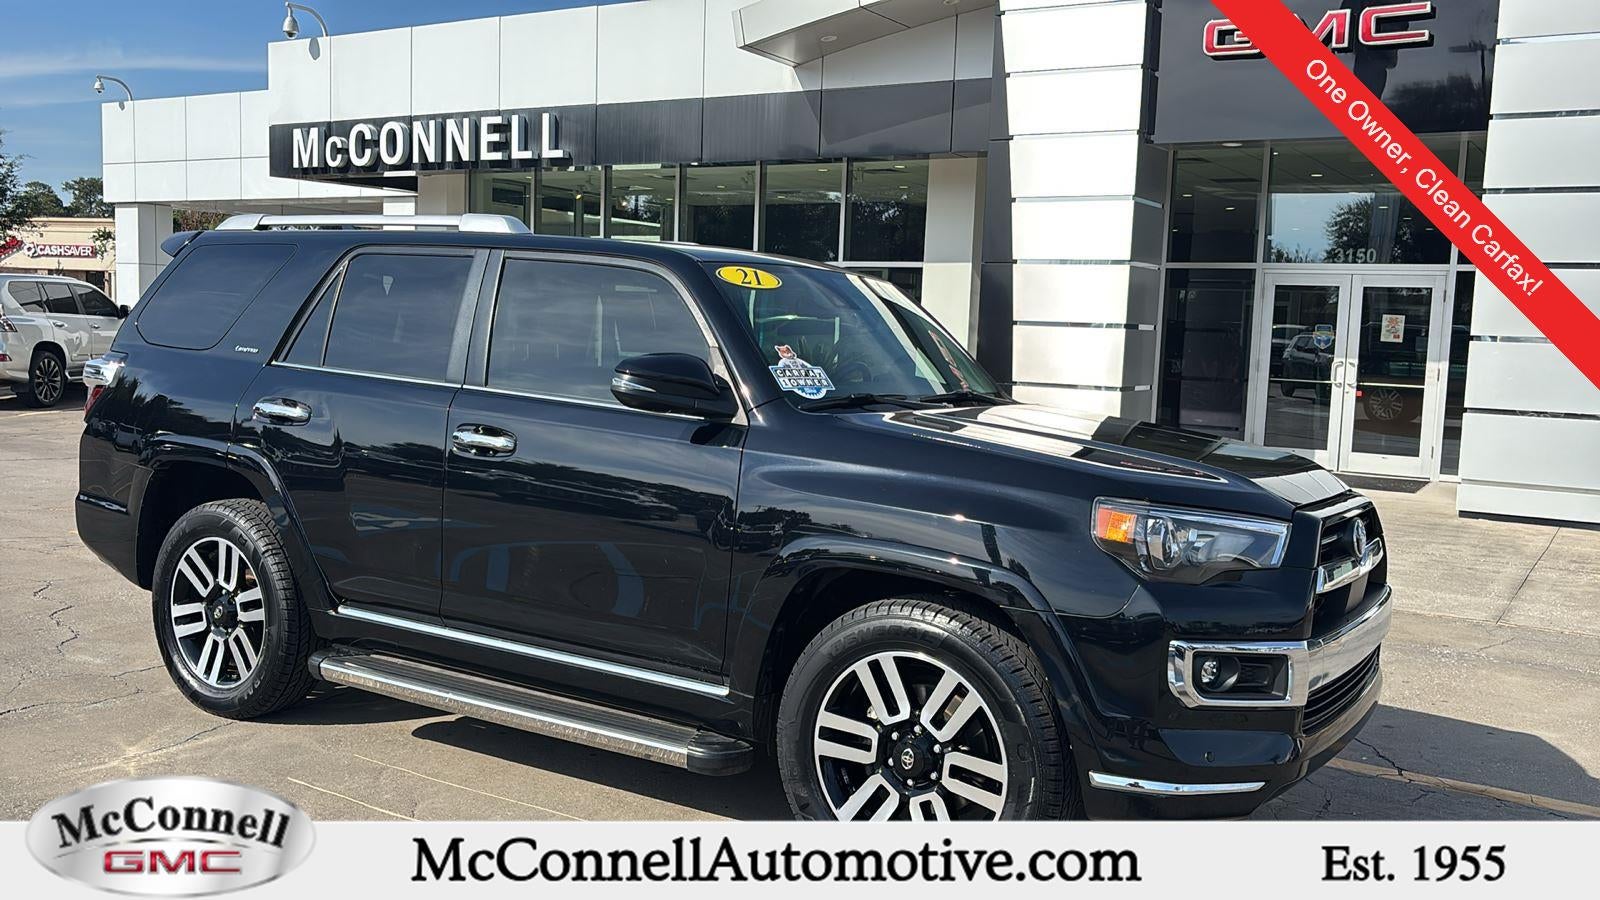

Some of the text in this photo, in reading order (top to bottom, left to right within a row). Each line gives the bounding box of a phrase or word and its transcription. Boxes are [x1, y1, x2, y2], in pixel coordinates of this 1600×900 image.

[292, 112, 564, 168] McCONNELL
[1333, 248, 1377, 263] 3150
[735, 268, 765, 286] 21
[776, 369, 823, 379] CARFAX
